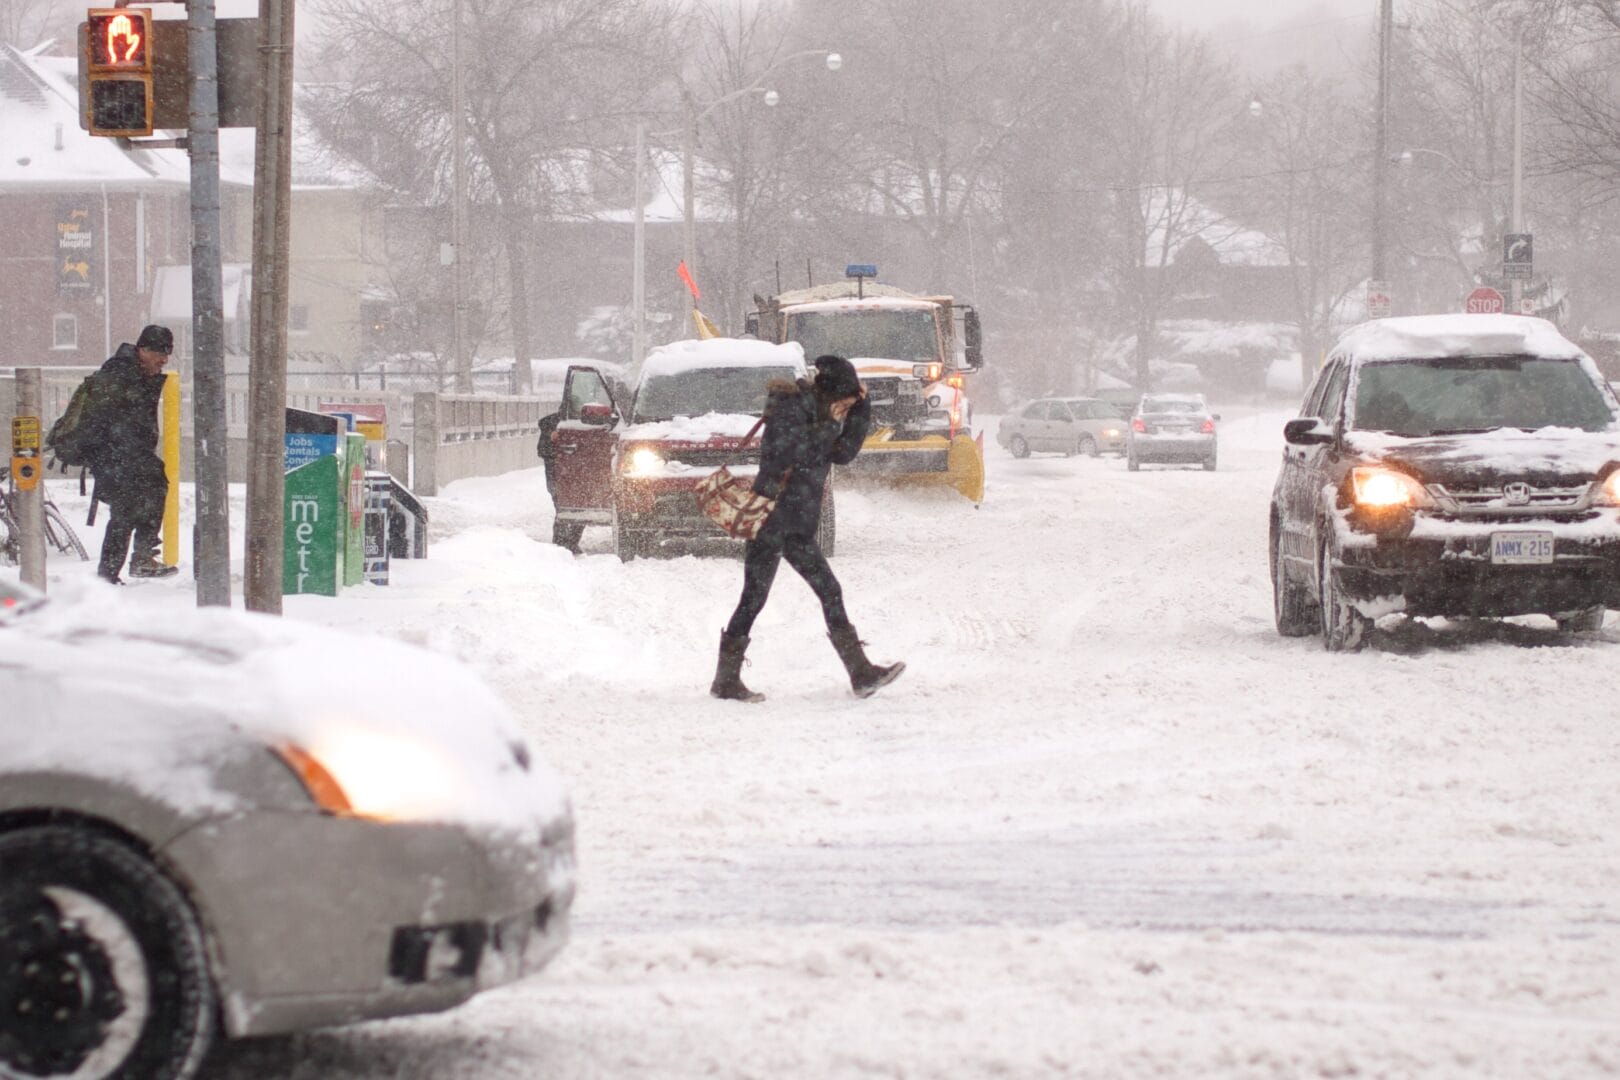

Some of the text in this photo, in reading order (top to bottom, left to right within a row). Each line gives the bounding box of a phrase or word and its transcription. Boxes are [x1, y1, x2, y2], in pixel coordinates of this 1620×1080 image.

[1468, 299, 1500, 313] STOP
[289, 437, 313, 446] Jobs
[1529, 541, 1551, 556] 215
